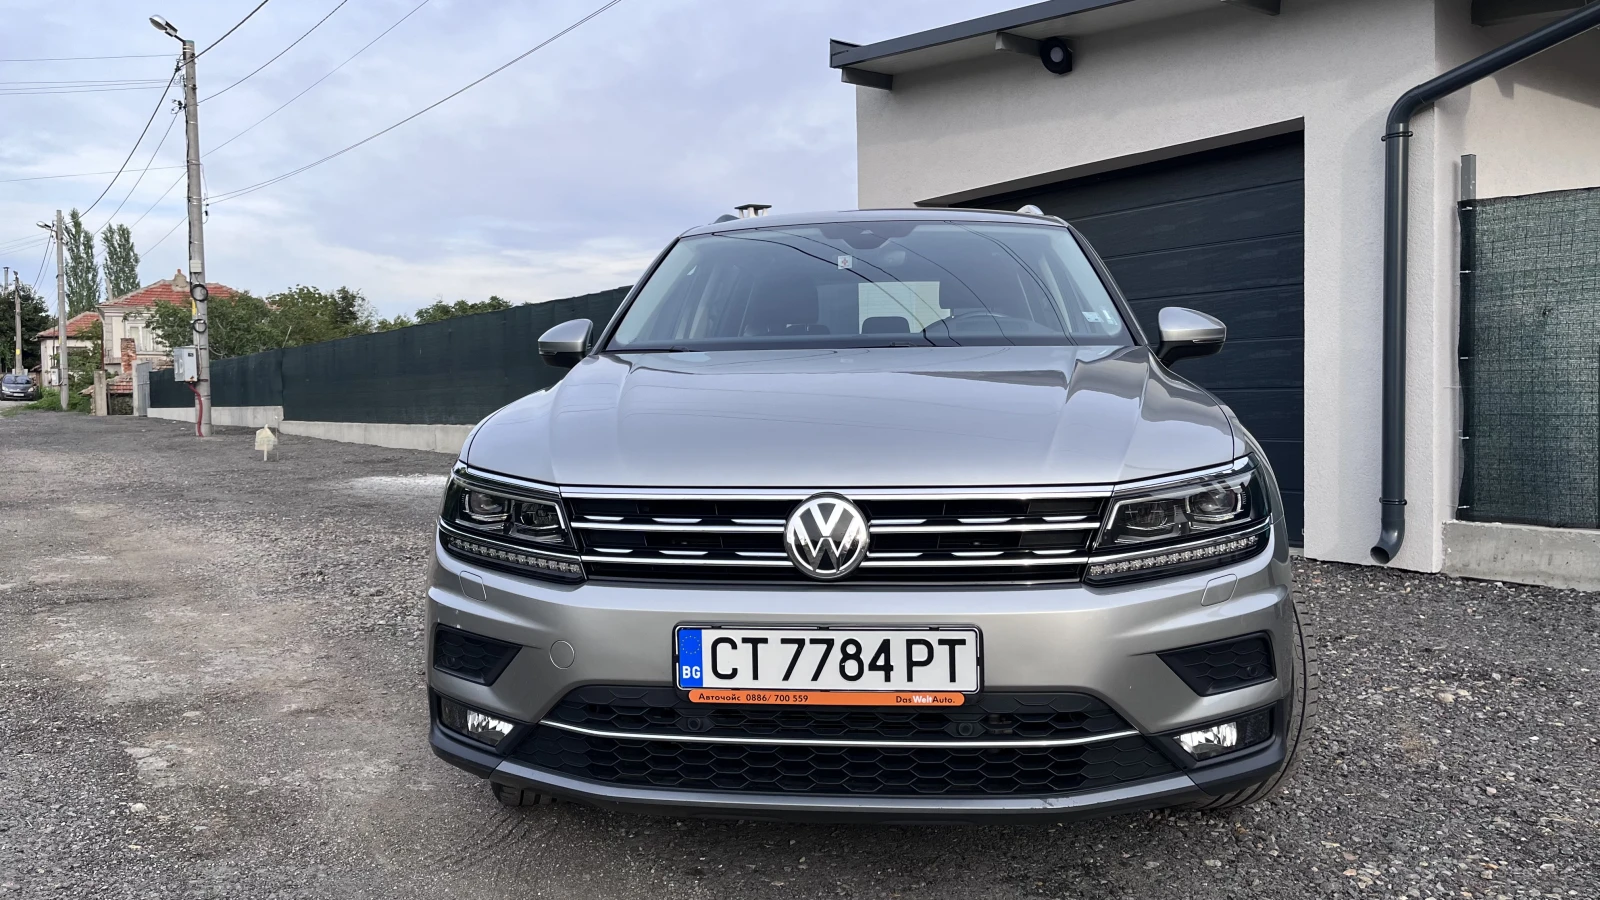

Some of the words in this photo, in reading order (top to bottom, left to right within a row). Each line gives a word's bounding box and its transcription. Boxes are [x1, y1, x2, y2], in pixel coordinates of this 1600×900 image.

[710, 636, 769, 681] CT
[780, 637, 894, 683] 7784
[906, 638, 967, 683] PT
[682, 665, 701, 679] BG
[698, 693, 741, 701] Авточойс
[745, 693, 772, 702] 0886/
[774, 694, 790, 702] 700
[792, 694, 809, 703] 559
[895, 695, 912, 704] Das
